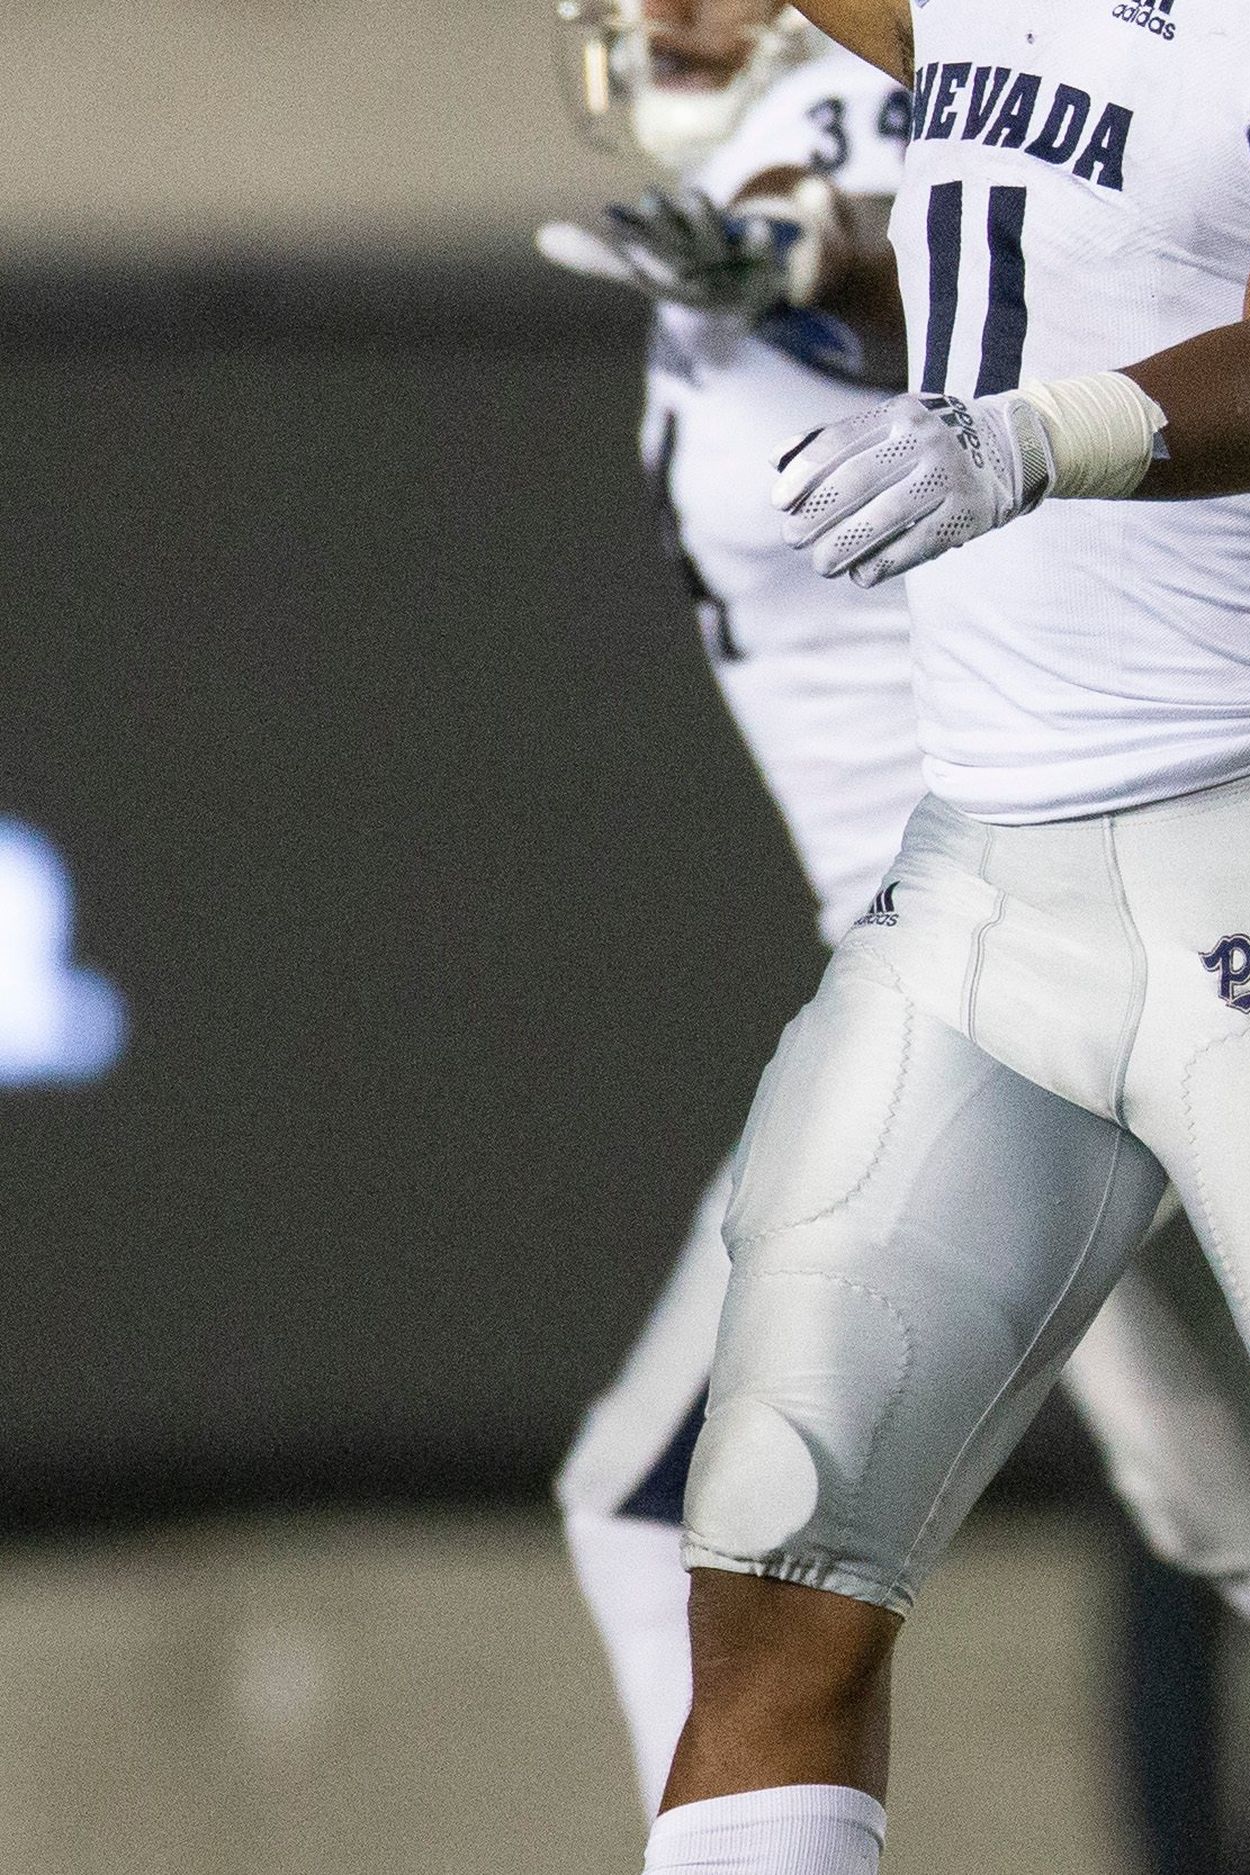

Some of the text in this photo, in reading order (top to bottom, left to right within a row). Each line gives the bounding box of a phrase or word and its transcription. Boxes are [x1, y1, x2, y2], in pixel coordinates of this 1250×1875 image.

[1112, 3, 1176, 41] adidas
[913, 62, 1134, 191] NEVADA
[922, 181, 1027, 399] 11
